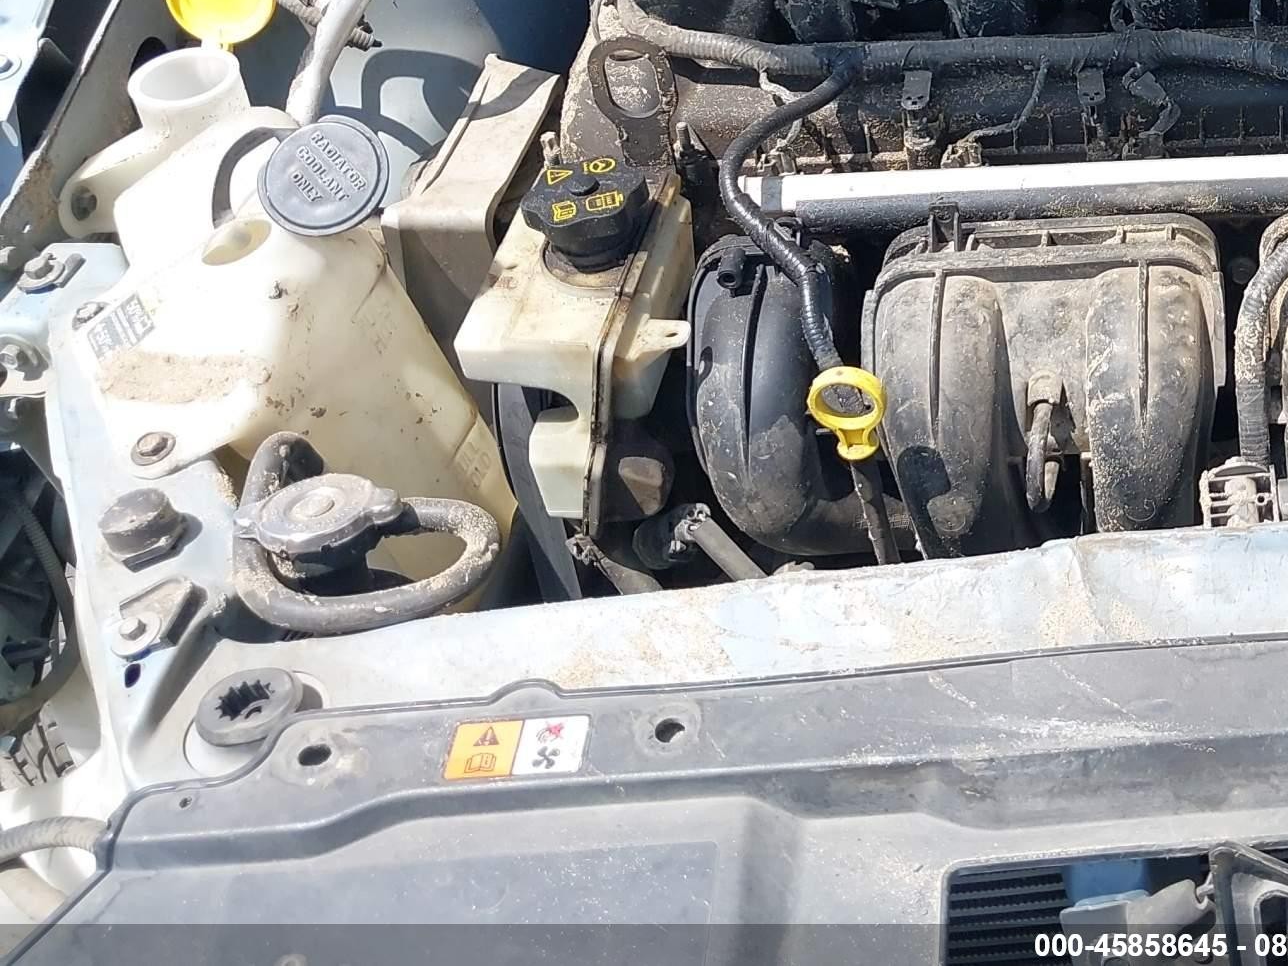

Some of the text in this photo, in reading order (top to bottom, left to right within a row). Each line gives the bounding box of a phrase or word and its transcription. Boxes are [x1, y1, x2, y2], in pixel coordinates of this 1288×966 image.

[291, 170, 323, 203] ONLY
[296, 145, 351, 202] COOLANT
[311, 130, 368, 192] RADIATOR
